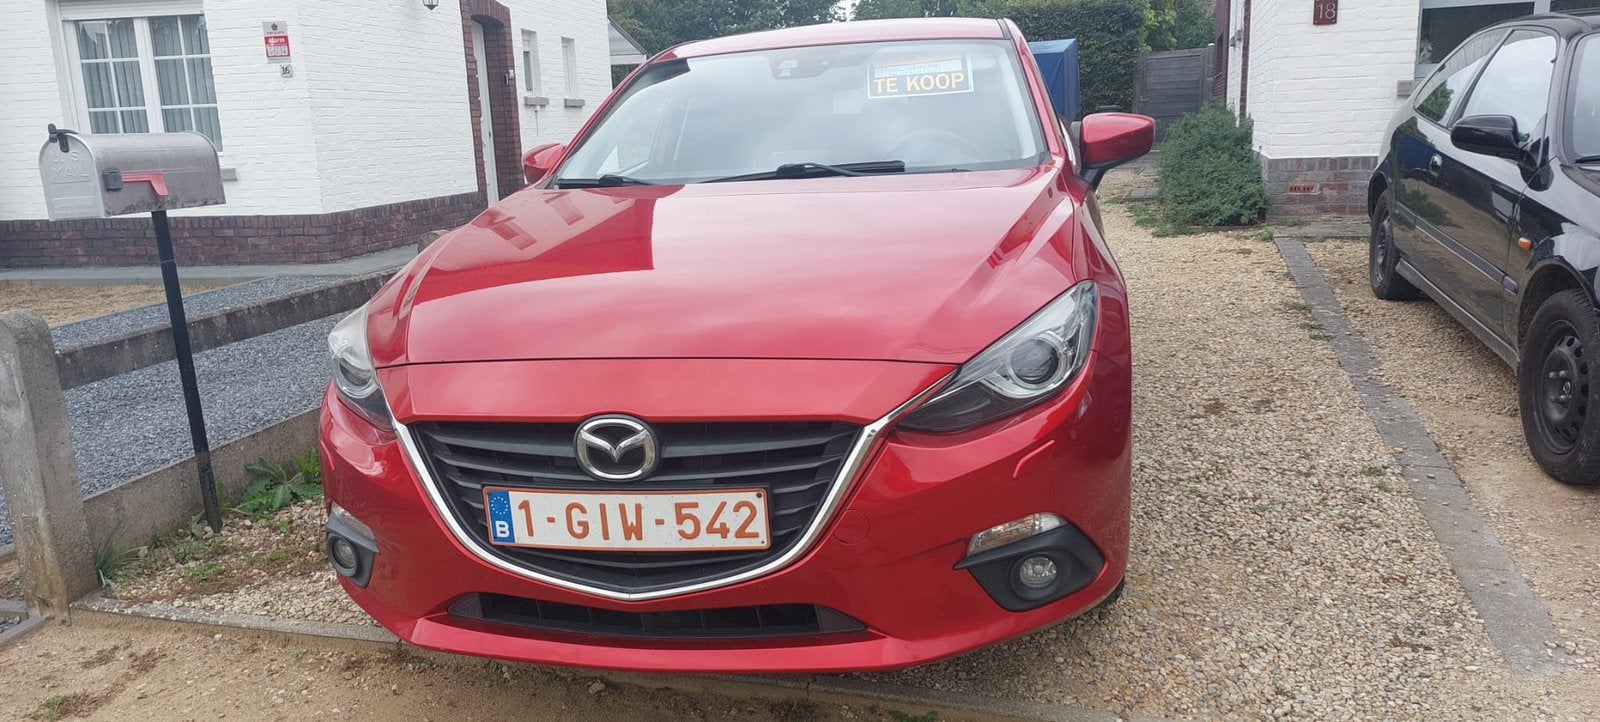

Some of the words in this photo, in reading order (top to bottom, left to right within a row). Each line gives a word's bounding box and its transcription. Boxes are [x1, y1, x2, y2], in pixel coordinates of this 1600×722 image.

[1316, 3, 1336, 19] 18
[281, 66, 291, 75] 16
[873, 77, 898, 94] TE
[906, 72, 965, 92] KOOP
[495, 520, 511, 538] B
[518, 499, 760, 541] 1-GIW-542
